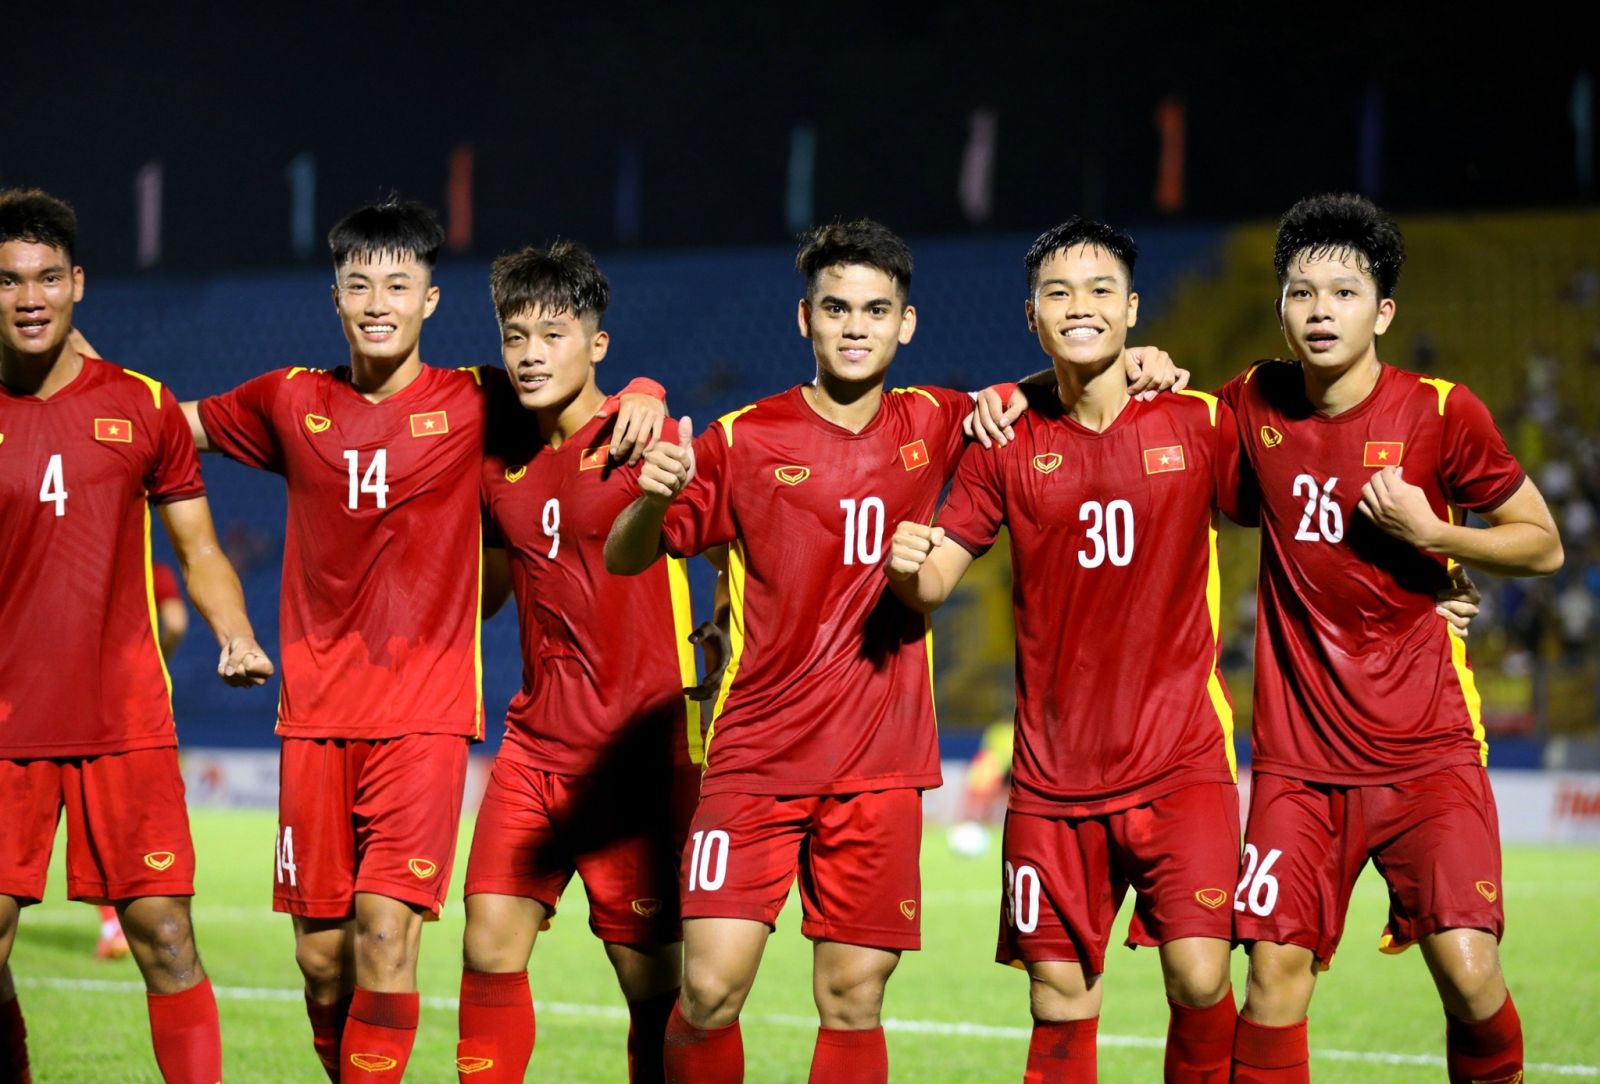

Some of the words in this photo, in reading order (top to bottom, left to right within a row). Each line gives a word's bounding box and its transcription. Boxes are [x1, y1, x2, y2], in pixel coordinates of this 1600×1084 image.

[40, 454, 68, 517] 4
[343, 449, 389, 510] 14
[1293, 474, 1344, 544] 26
[541, 498, 561, 560] 9
[839, 497, 884, 565] 10
[1078, 499, 1135, 568] 30
[276, 825, 297, 886] 14
[688, 829, 730, 892] 10
[1234, 843, 1283, 917] 26
[1005, 861, 1040, 933] 30
